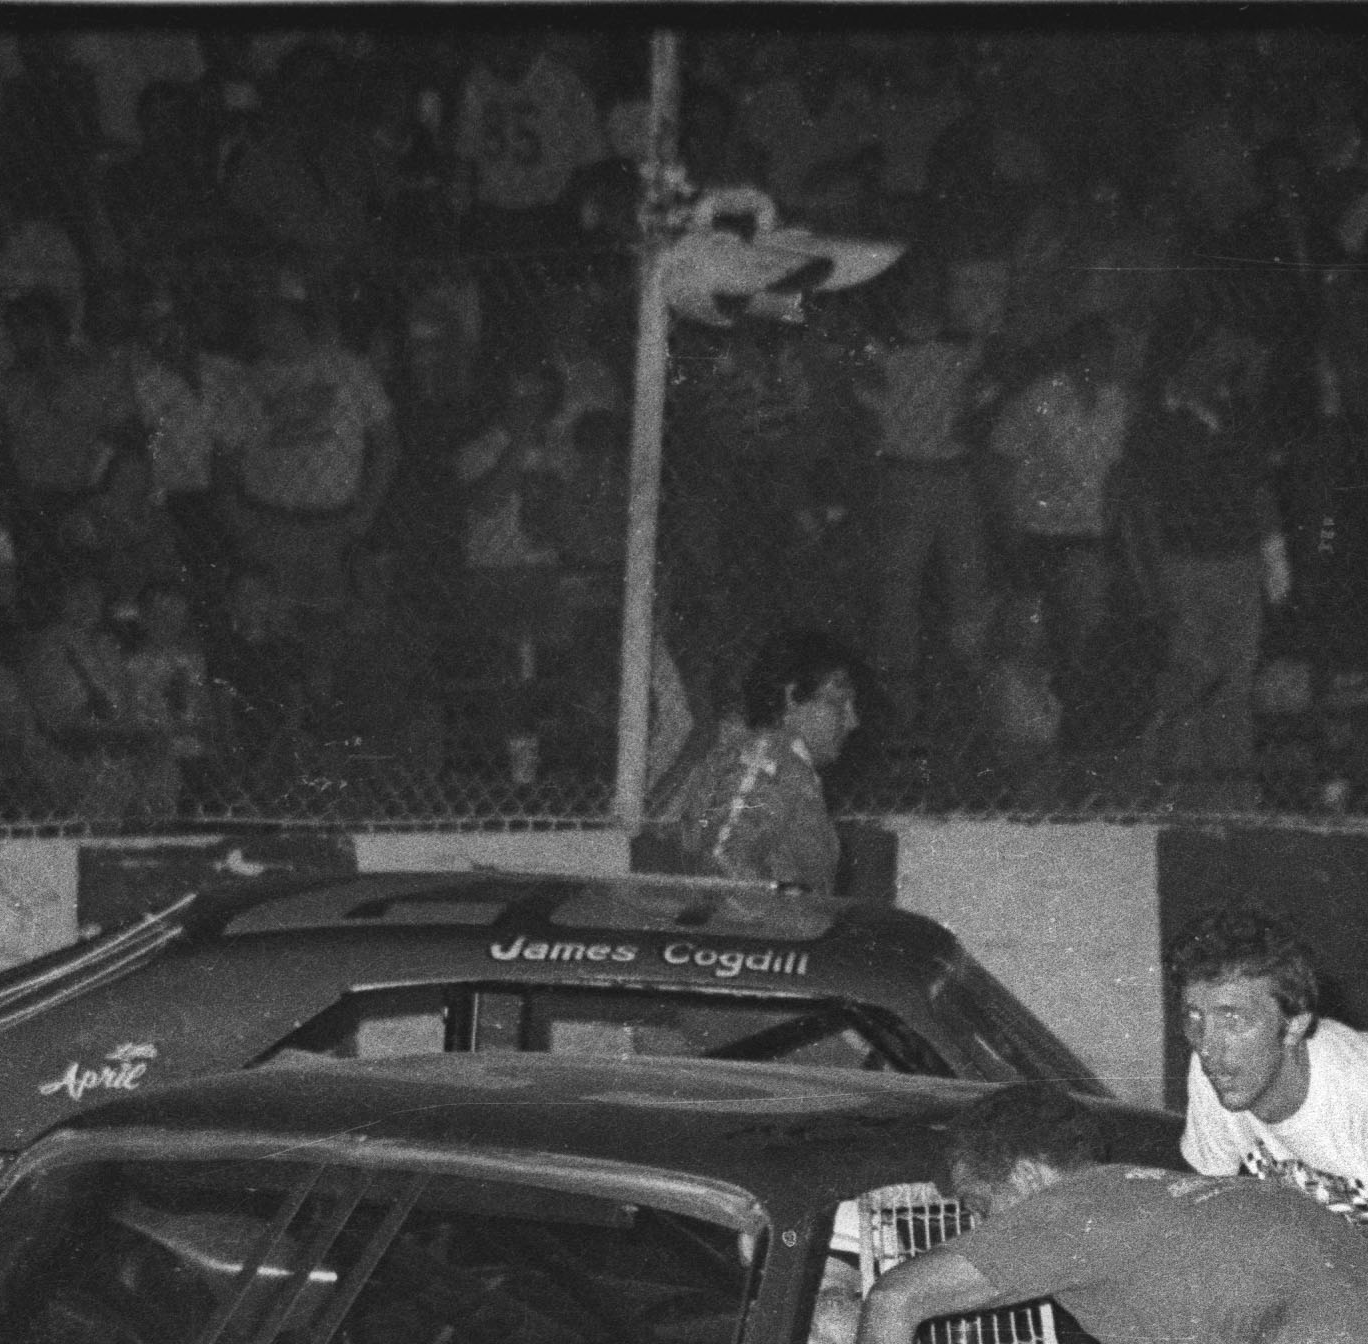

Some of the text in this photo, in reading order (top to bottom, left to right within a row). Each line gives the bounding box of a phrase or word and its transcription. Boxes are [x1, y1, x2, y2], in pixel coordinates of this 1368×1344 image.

[490, 936, 809, 978] James Cogdill
[38, 1062, 147, 1101] April
